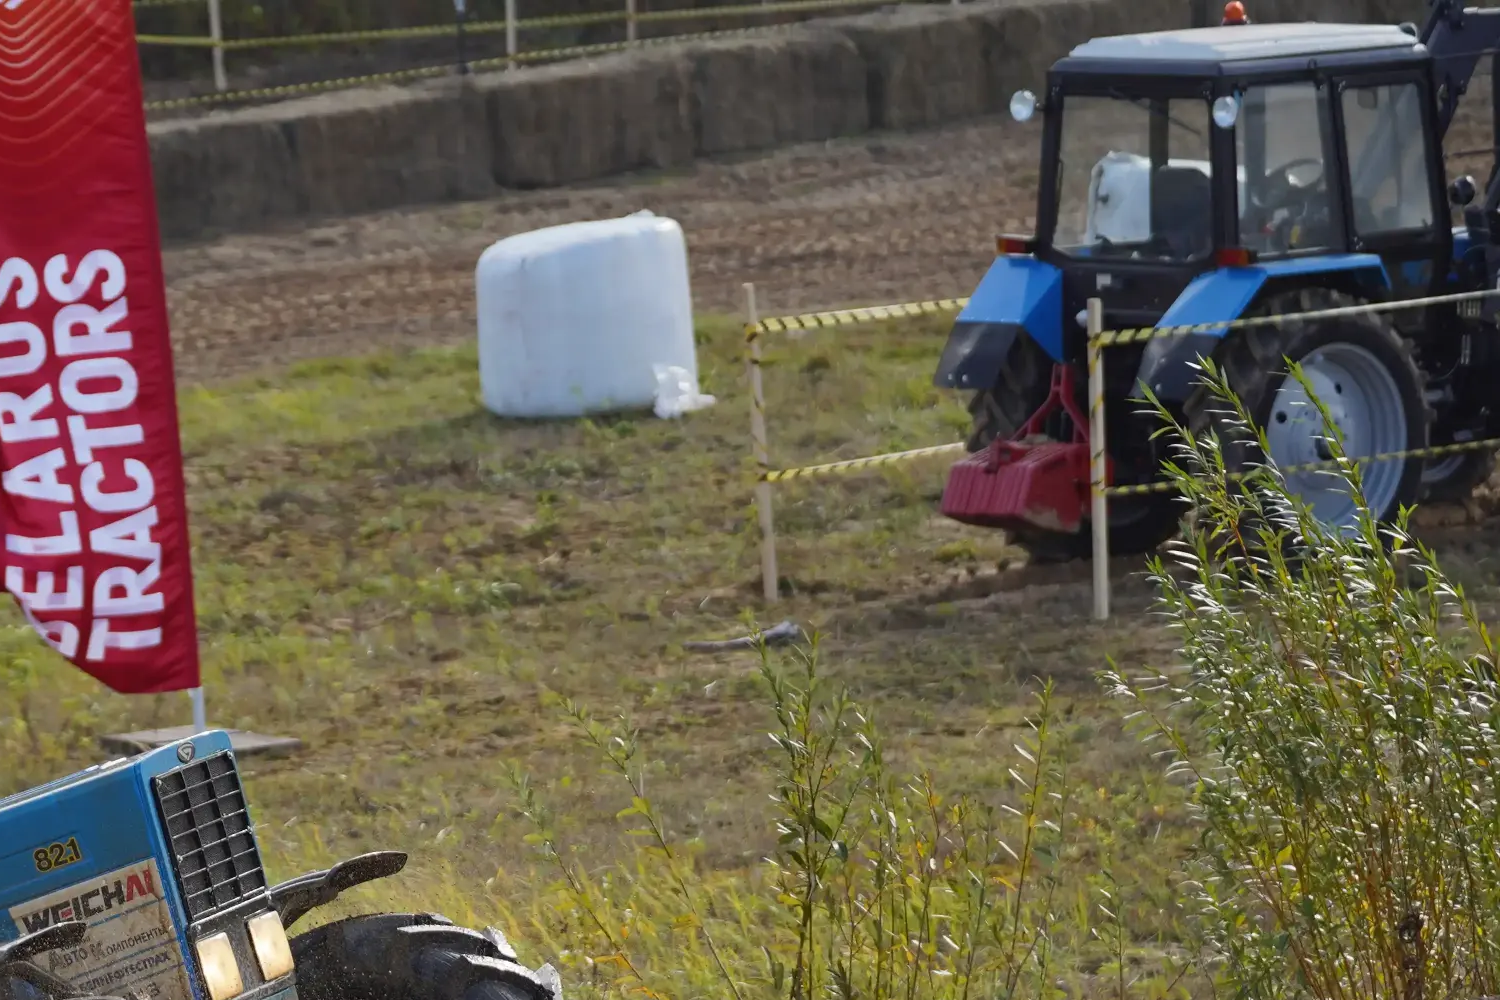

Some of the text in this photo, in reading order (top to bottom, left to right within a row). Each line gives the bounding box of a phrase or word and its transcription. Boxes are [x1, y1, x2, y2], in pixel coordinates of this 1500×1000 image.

[43, 248, 166, 663] TRACTORS
[33, 836, 83, 873] 82.1
[21, 869, 155, 936] WEICHAI
